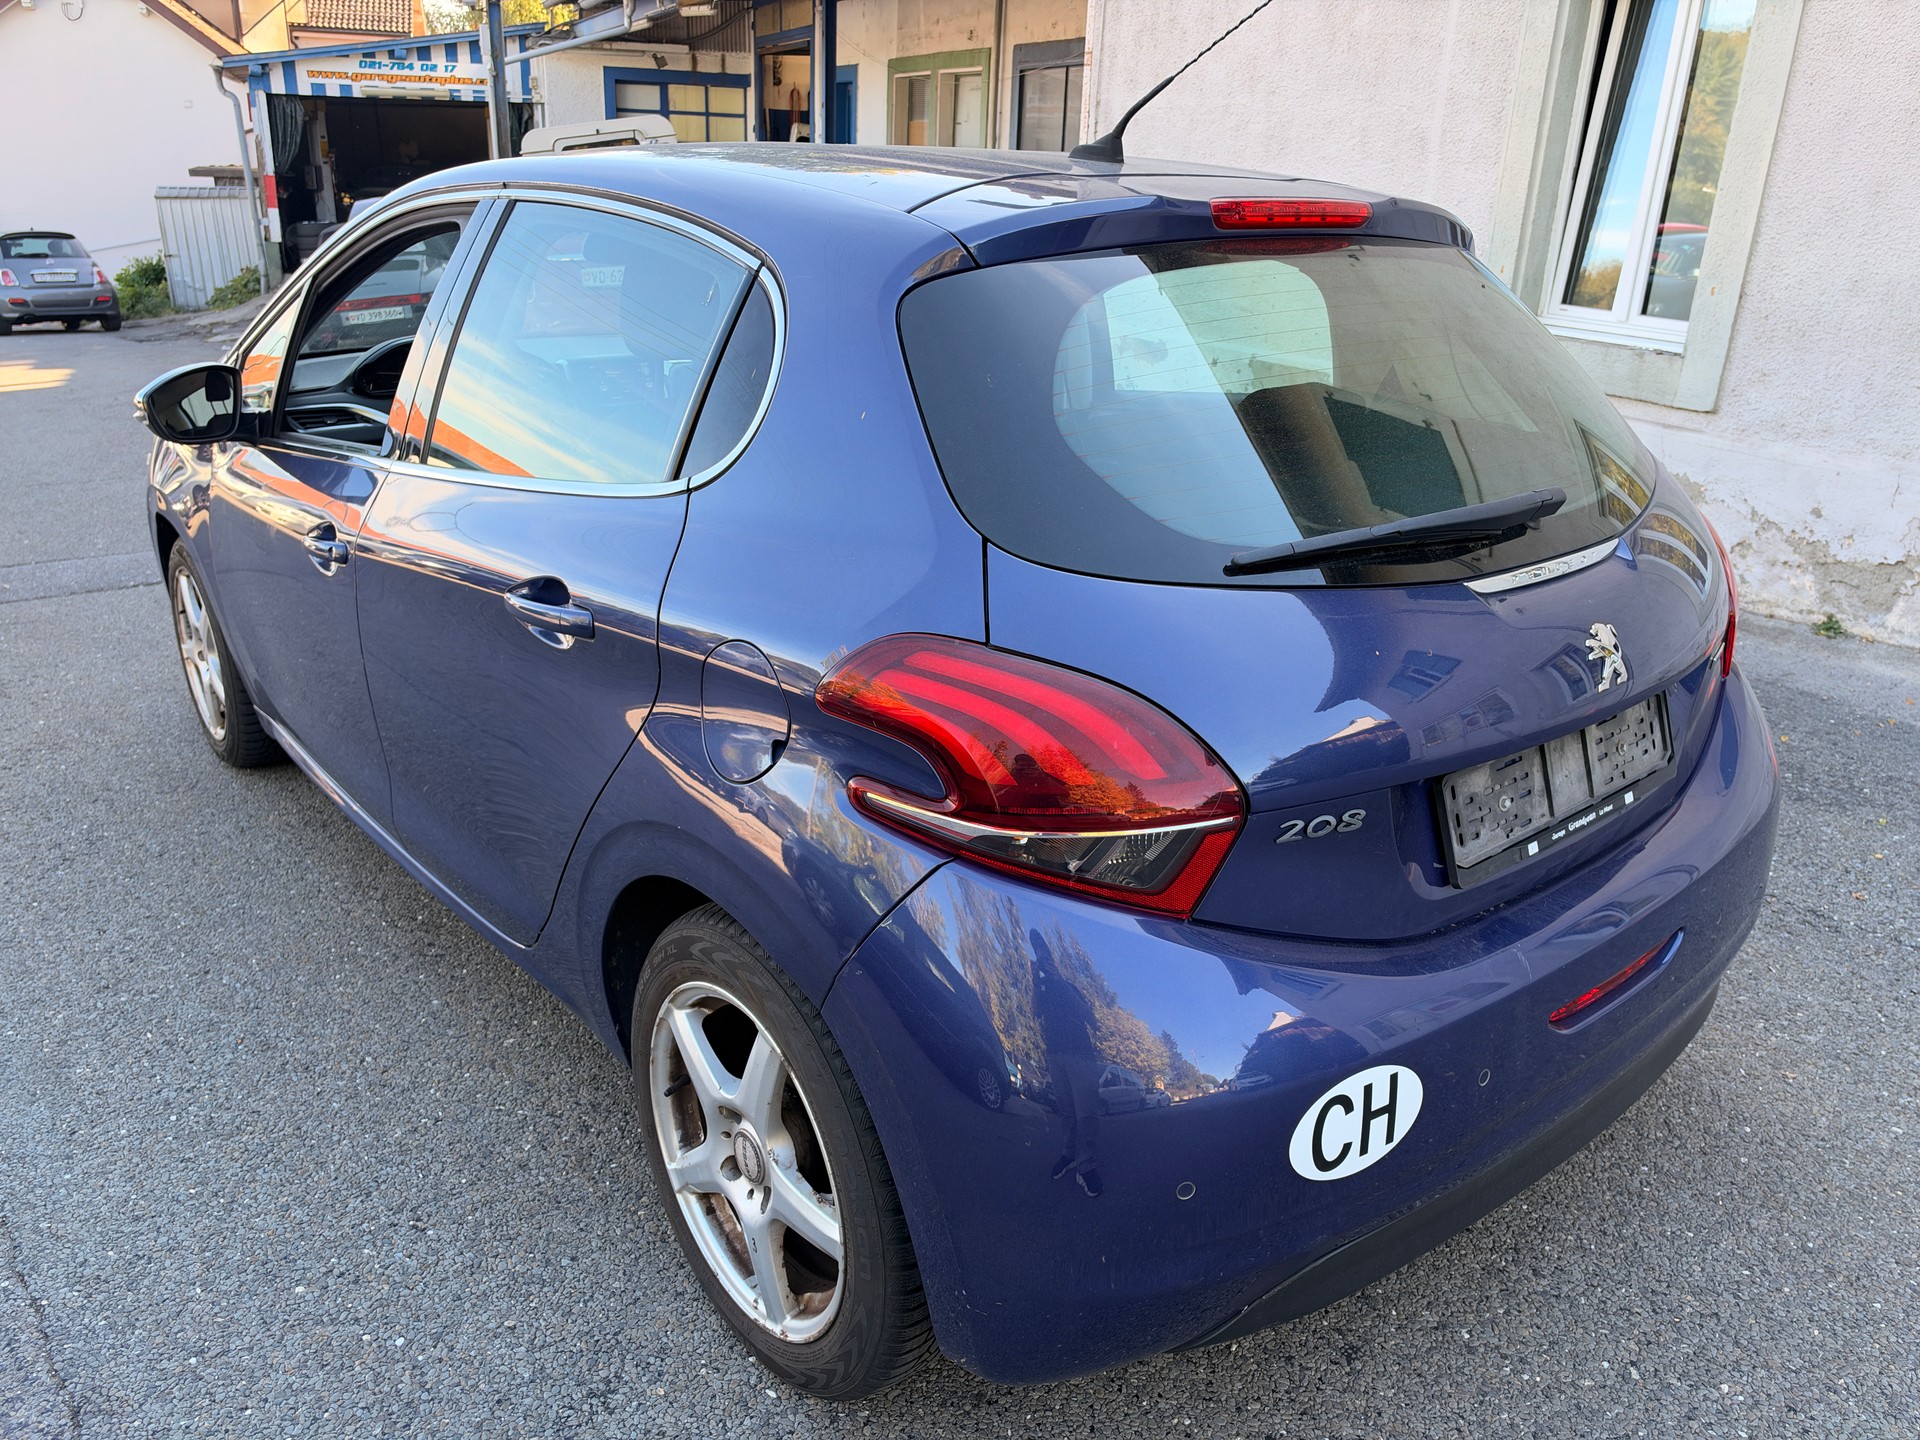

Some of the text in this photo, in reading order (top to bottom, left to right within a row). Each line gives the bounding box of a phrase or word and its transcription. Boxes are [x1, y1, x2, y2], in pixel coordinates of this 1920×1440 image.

[420, 63, 438, 72] 02
[443, 64, 457, 73] 17
[1275, 808, 1367, 844] 208
[1312, 1071, 1399, 1172] CH
